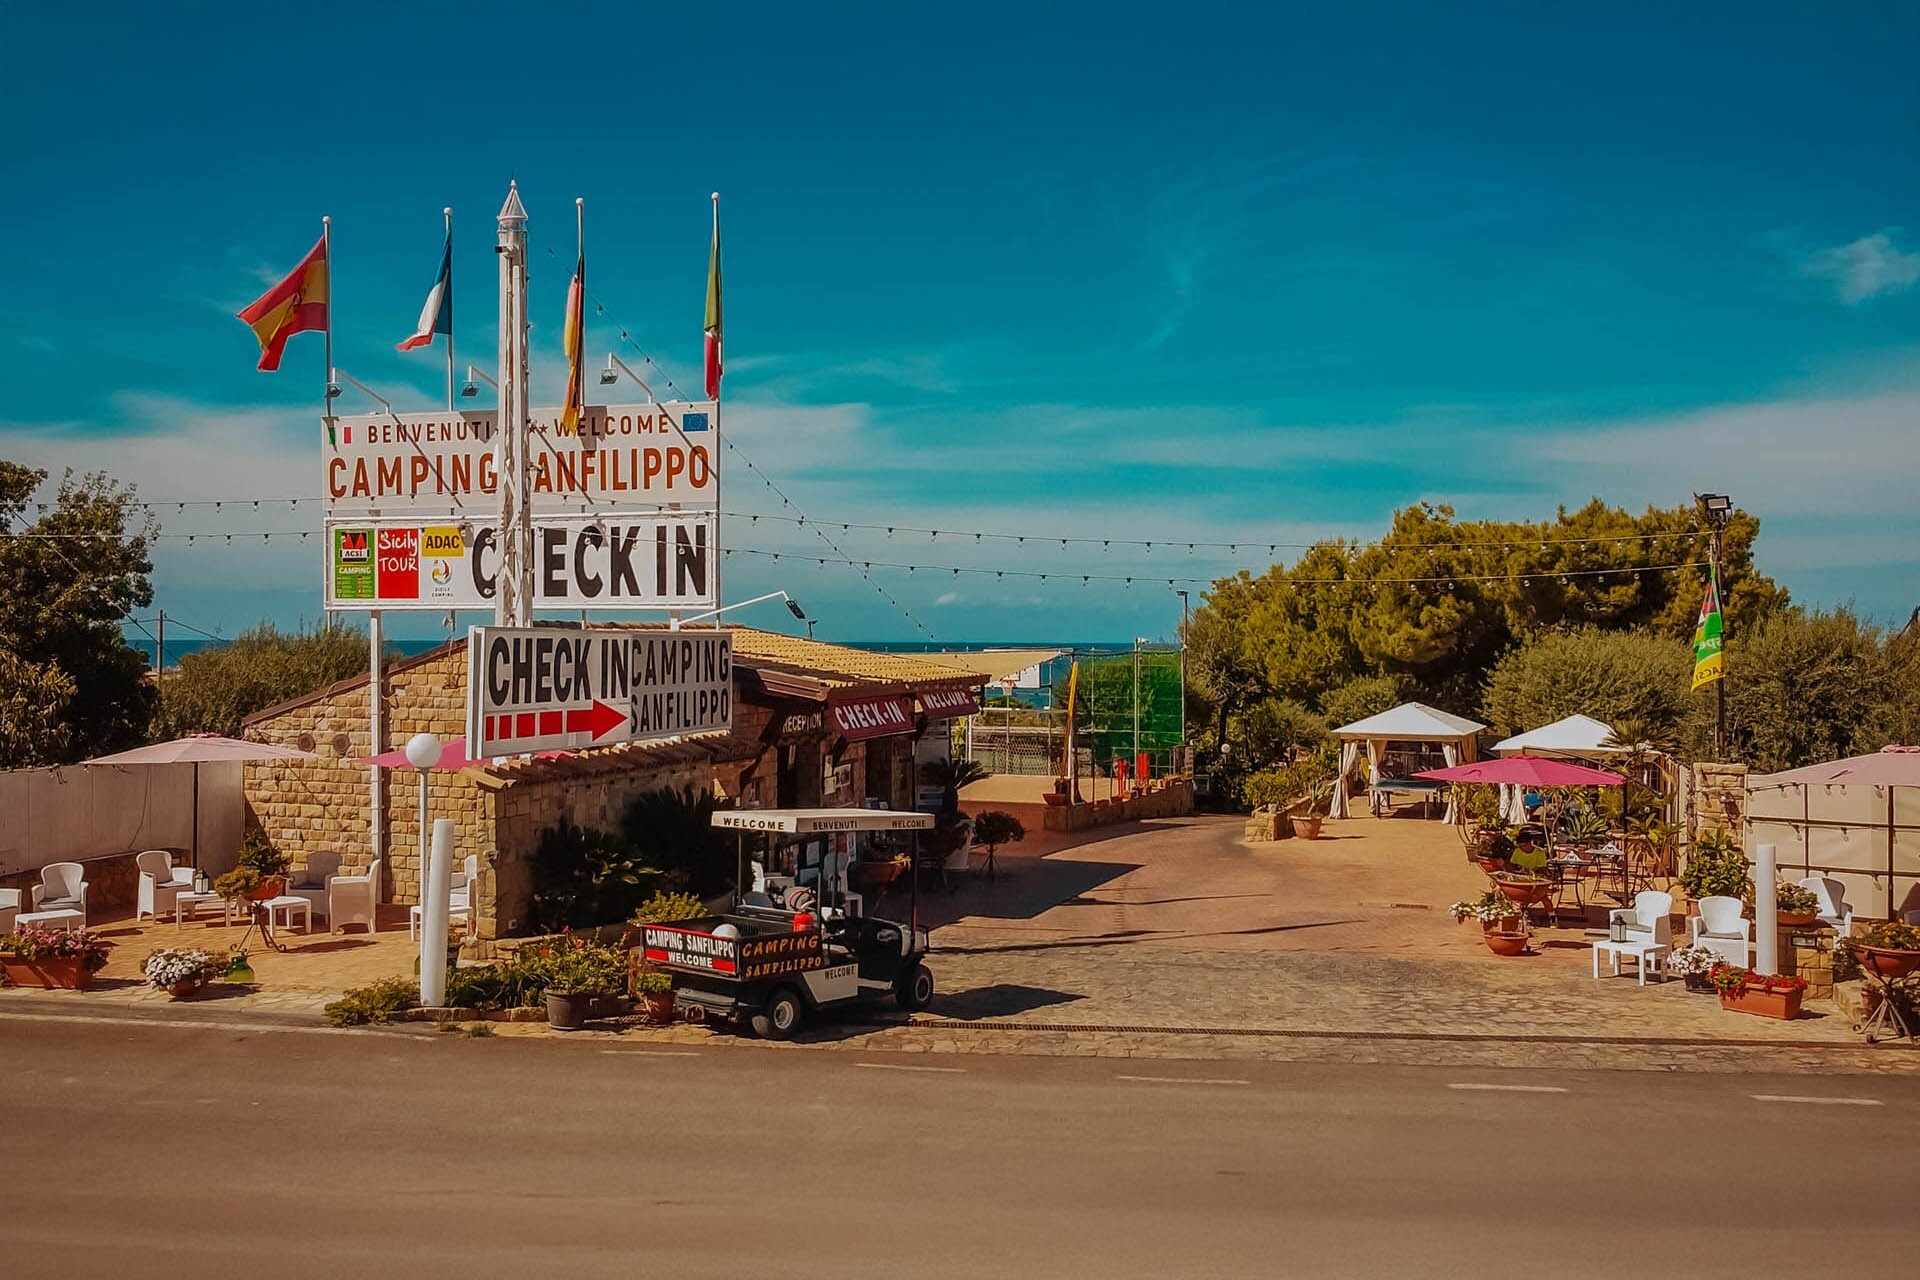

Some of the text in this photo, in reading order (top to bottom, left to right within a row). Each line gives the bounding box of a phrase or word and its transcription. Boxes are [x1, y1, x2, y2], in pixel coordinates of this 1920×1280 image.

[368, 413, 669, 443] BENVENUTI WELCOME
[329, 445, 710, 499] CAMPING ANFILIPPO
[379, 530, 418, 557] Sicily
[425, 535, 460, 549] ADAC
[379, 557, 418, 572] TOUR
[472, 524, 707, 599] CECK IN
[488, 636, 629, 706] CHECK IN
[631, 639, 729, 687] CAMPING
[631, 687, 729, 734] SANFILIPPO
[922, 690, 970, 709] WELCOME
[835, 700, 905, 730] CHECK-IN
[723, 817, 785, 831] WELCOME
[812, 819, 926, 830] BENVENUTI WELCOME
[645, 928, 735, 959] CAMPING SANFILIPPO
[742, 934, 819, 958] CAMPING
[668, 951, 713, 968] WELCOME
[824, 965, 856, 981] WELCOME
